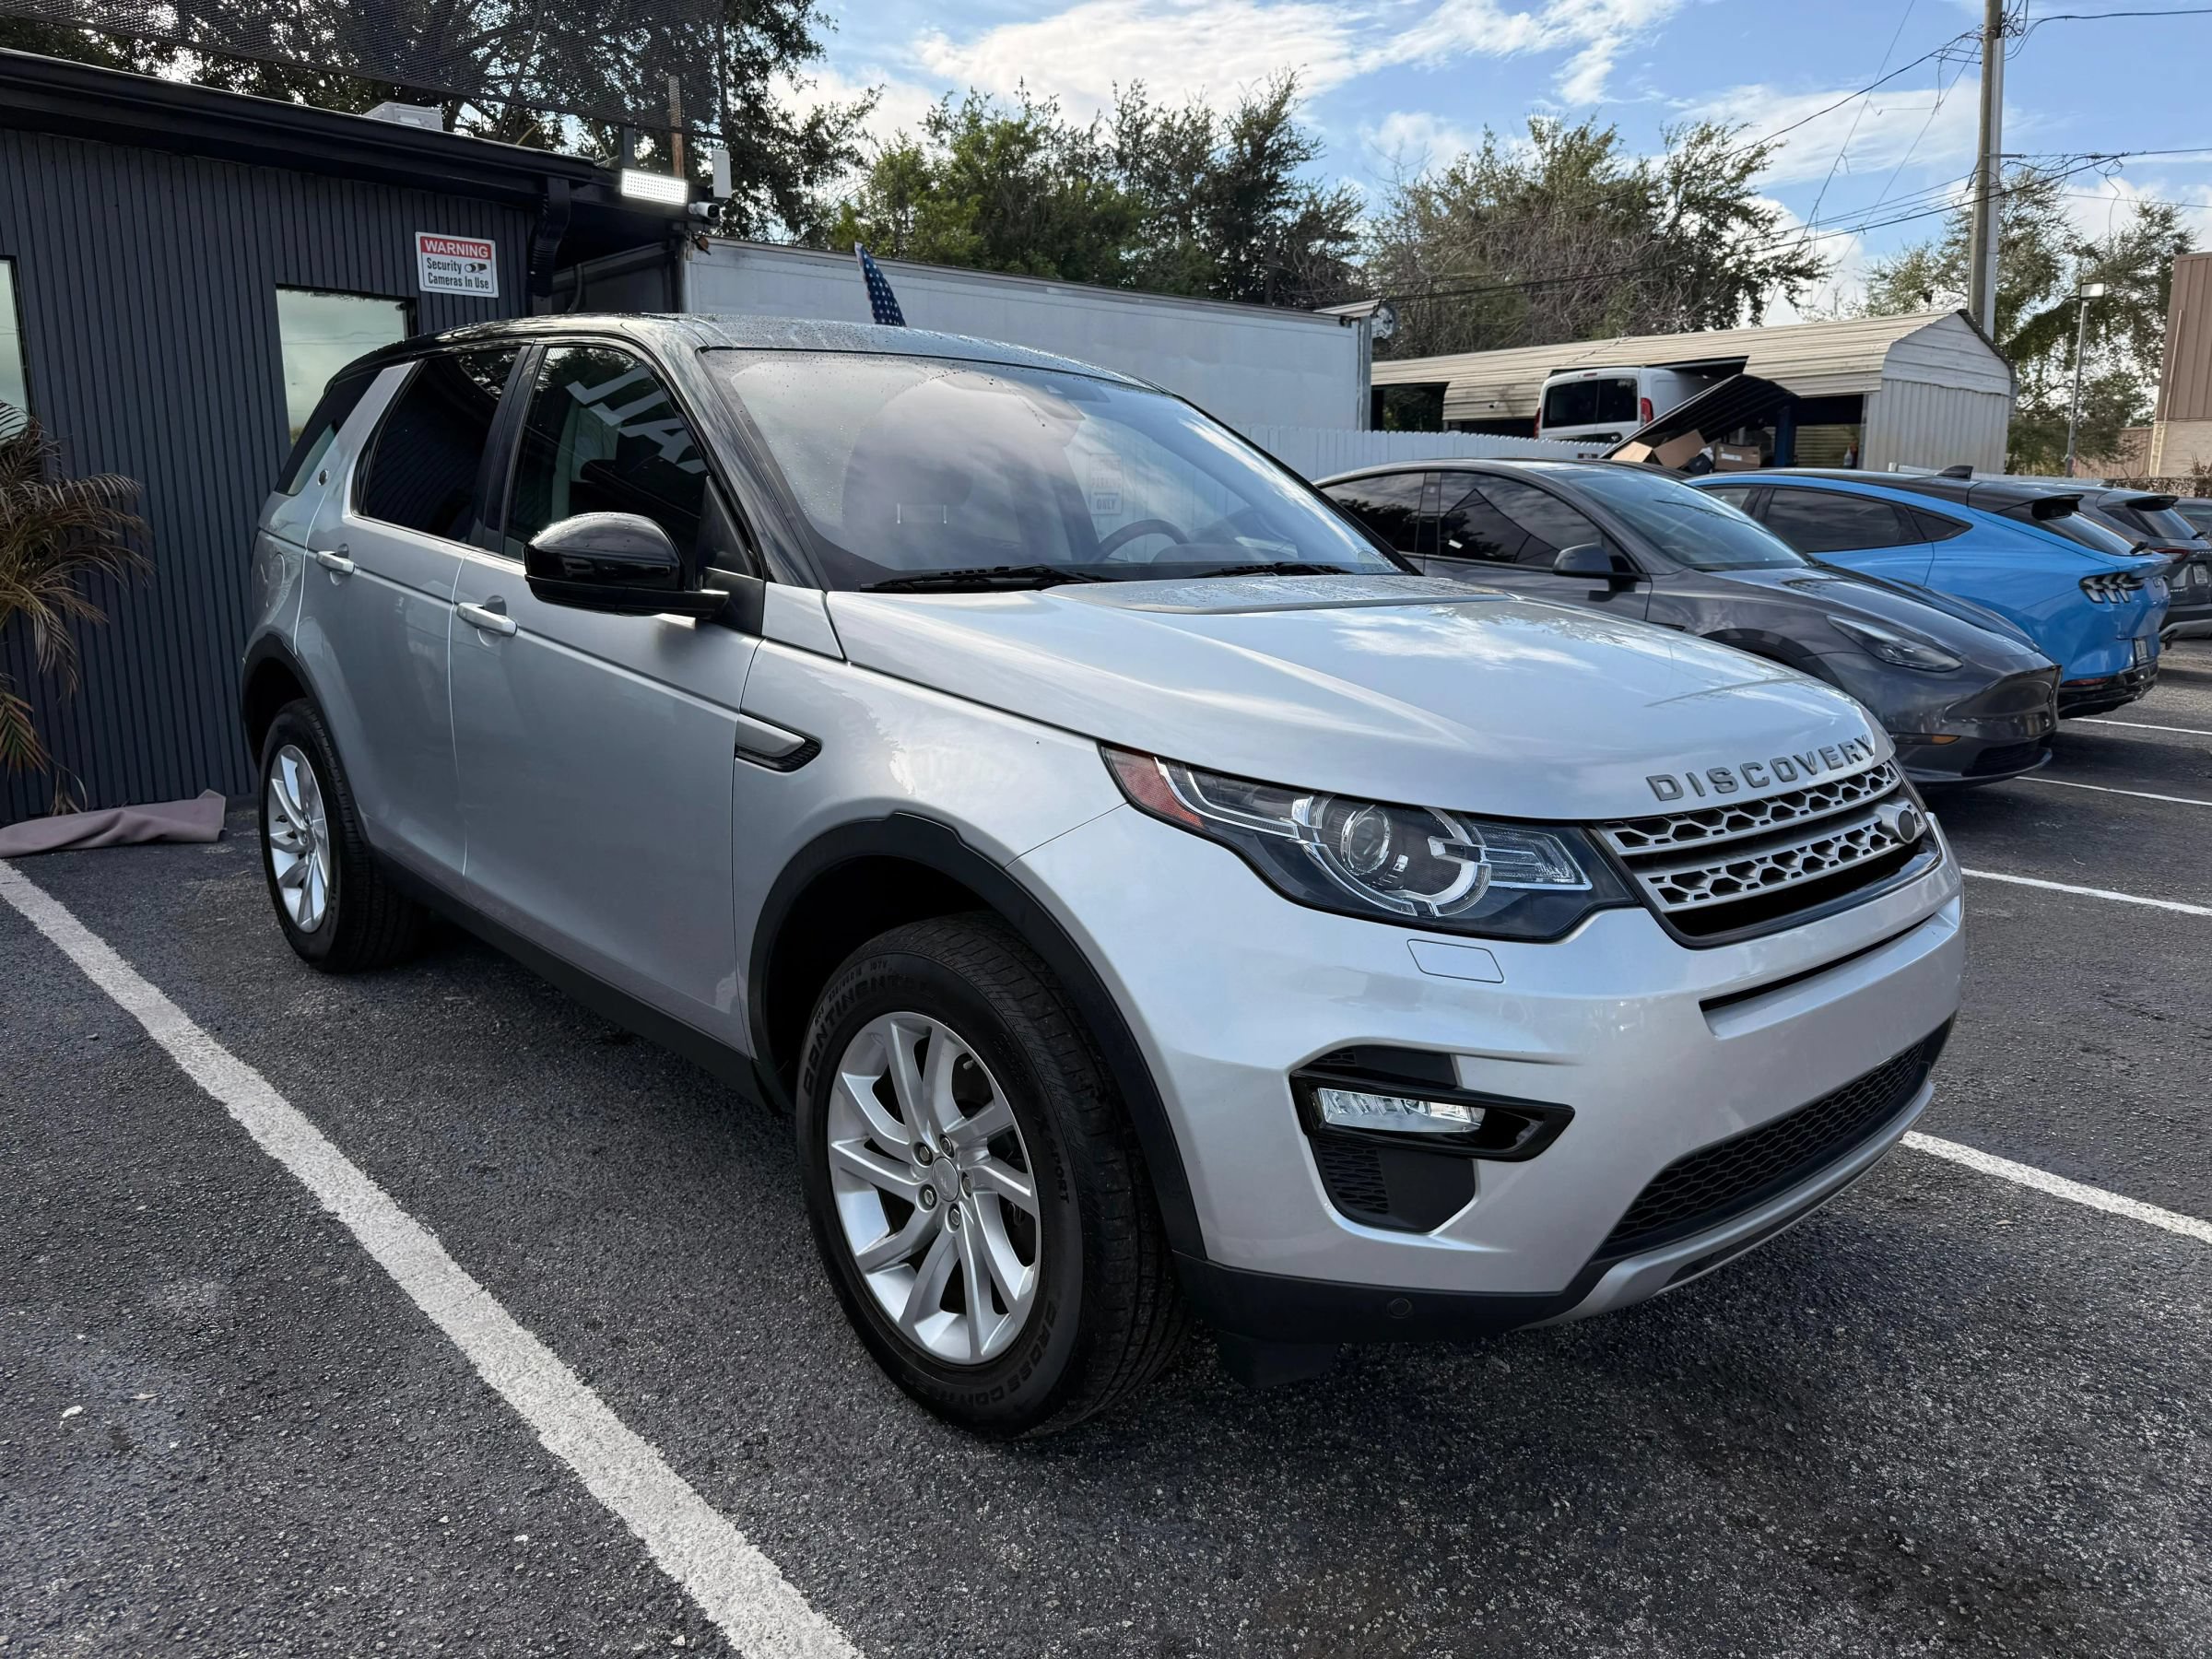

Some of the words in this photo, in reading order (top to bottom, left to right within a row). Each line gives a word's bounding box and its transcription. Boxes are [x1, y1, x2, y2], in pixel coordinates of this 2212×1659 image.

[425, 240, 488, 257] WARNING
[427, 257, 462, 274] Security
[428, 272, 463, 287] Cameras
[465, 276, 473, 288] In
[475, 276, 489, 289] Use
[1097, 499, 1116, 511] ONLY
[1646, 734, 1876, 802] DISCOVERY
